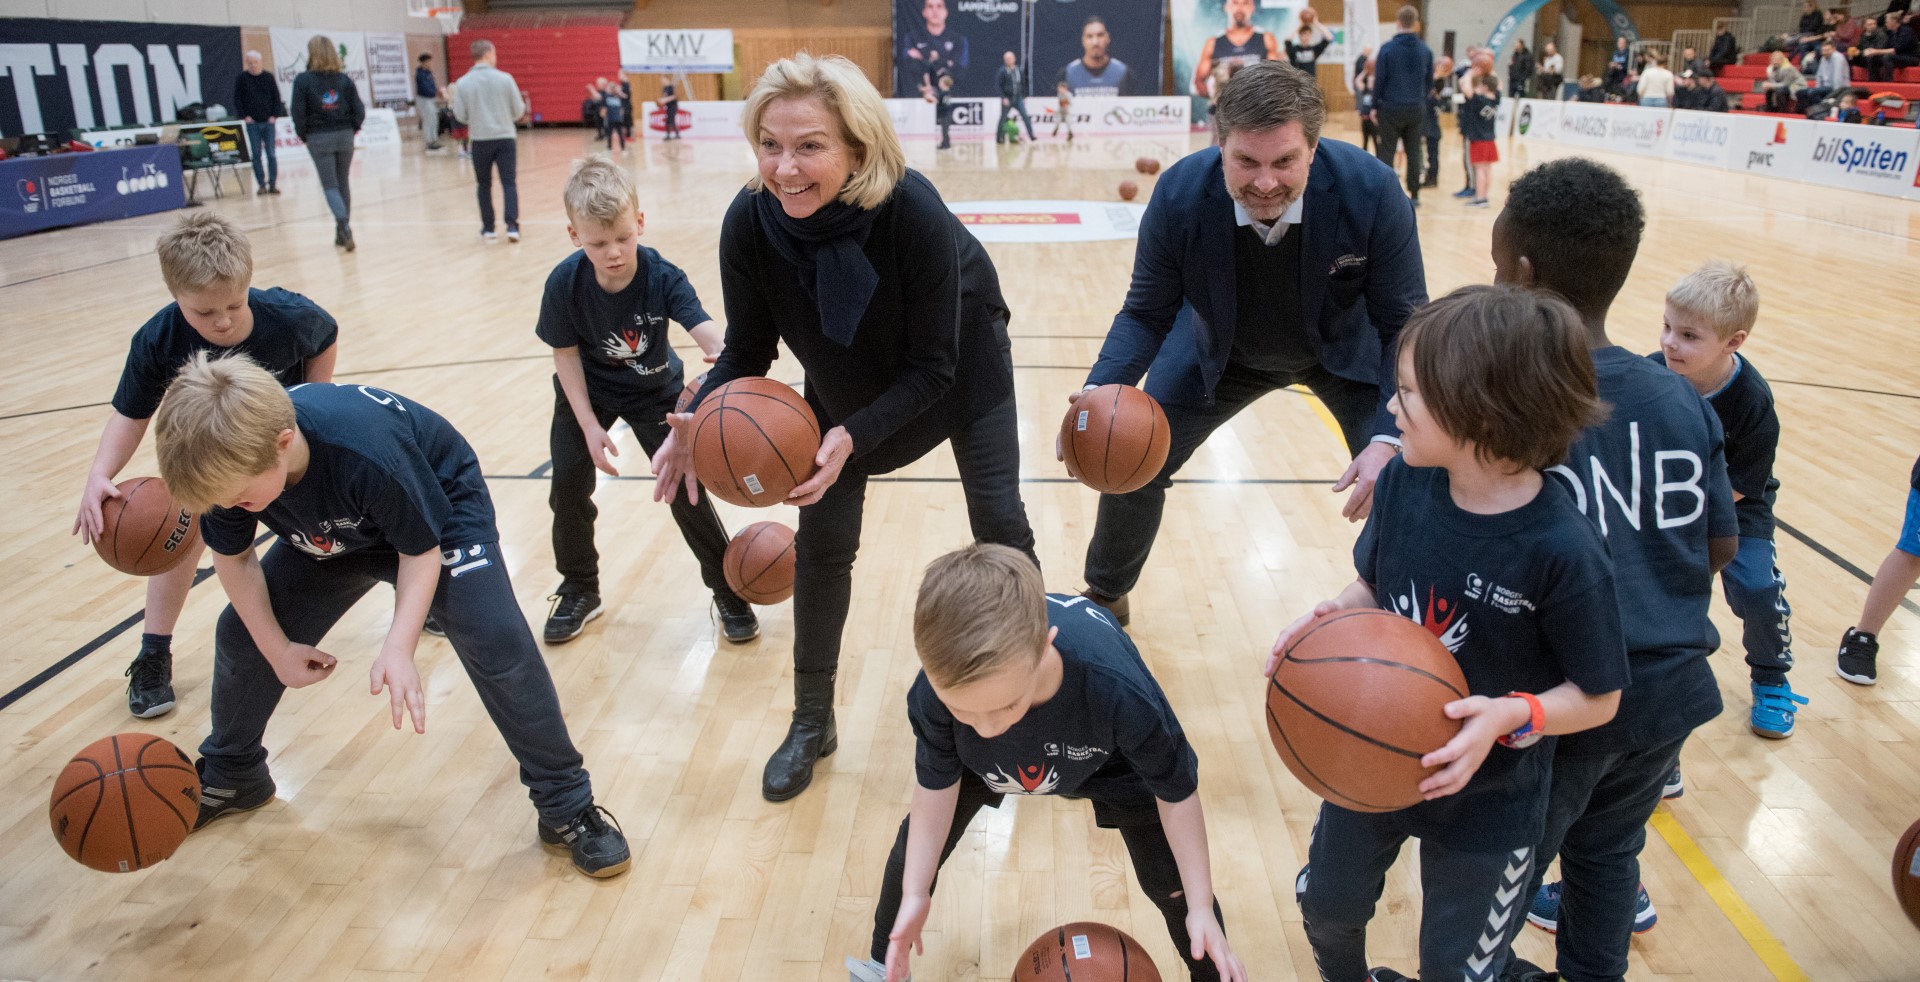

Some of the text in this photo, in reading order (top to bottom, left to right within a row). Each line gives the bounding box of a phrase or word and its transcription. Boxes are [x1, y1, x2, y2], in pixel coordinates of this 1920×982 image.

[648, 33, 705, 55] KMV
[1132, 103, 1183, 118] on4u
[1747, 150, 1775, 168] pwc
[1812, 136, 1907, 172] bilSpiten
[50, 182, 96, 197] BASKETBALL
[163, 508, 192, 553] SELEC
[1495, 585, 1523, 599] NORGES
[1066, 744, 1088, 752] NORGES
